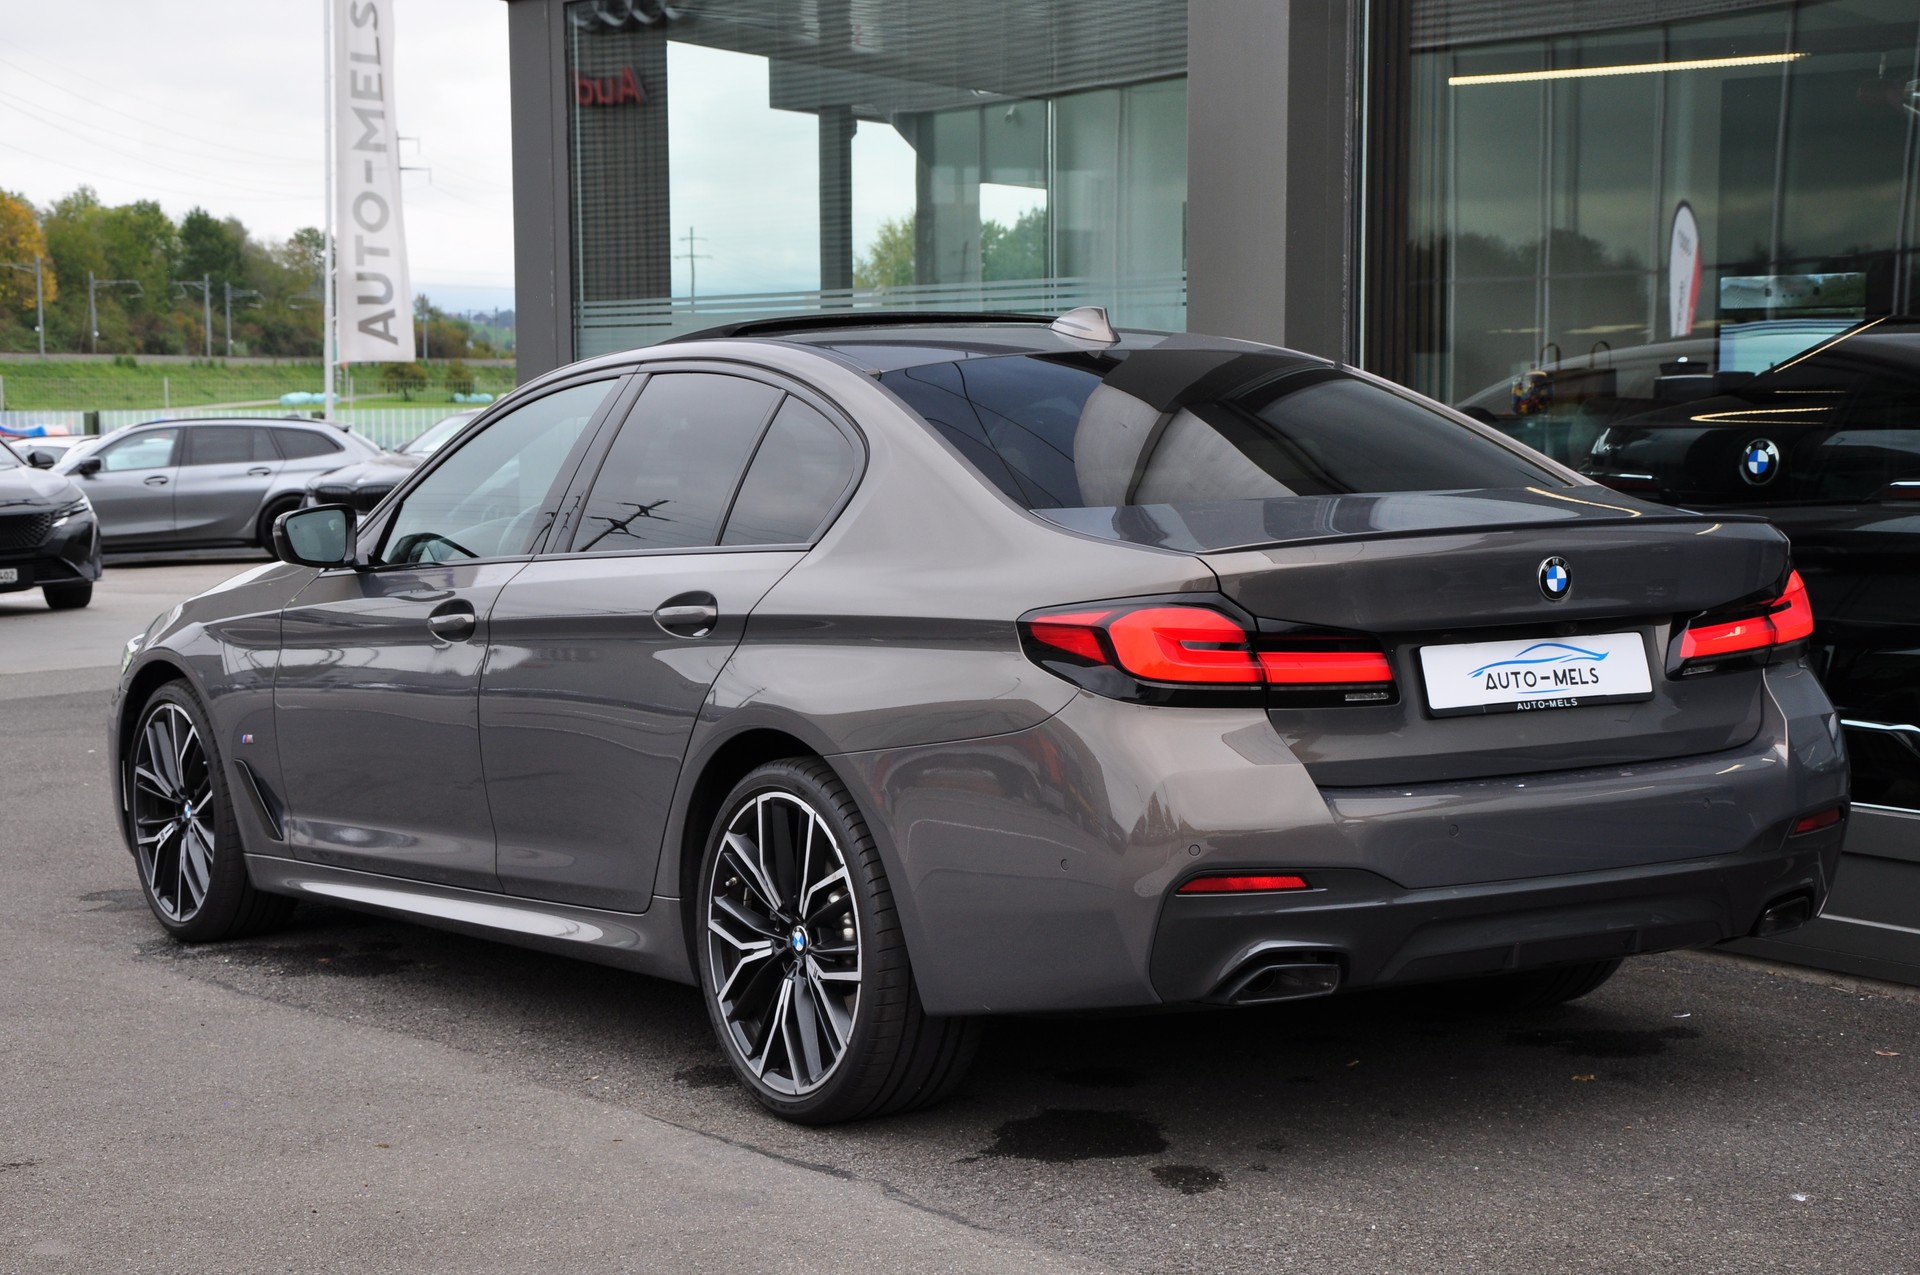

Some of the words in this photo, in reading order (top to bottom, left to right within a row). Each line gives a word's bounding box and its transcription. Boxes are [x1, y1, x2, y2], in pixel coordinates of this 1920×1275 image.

[350, 1, 398, 345] AUTO-MELS
[1485, 667, 1600, 690] AUTO-MELS
[1517, 698, 1578, 710] AUTO-MELS
